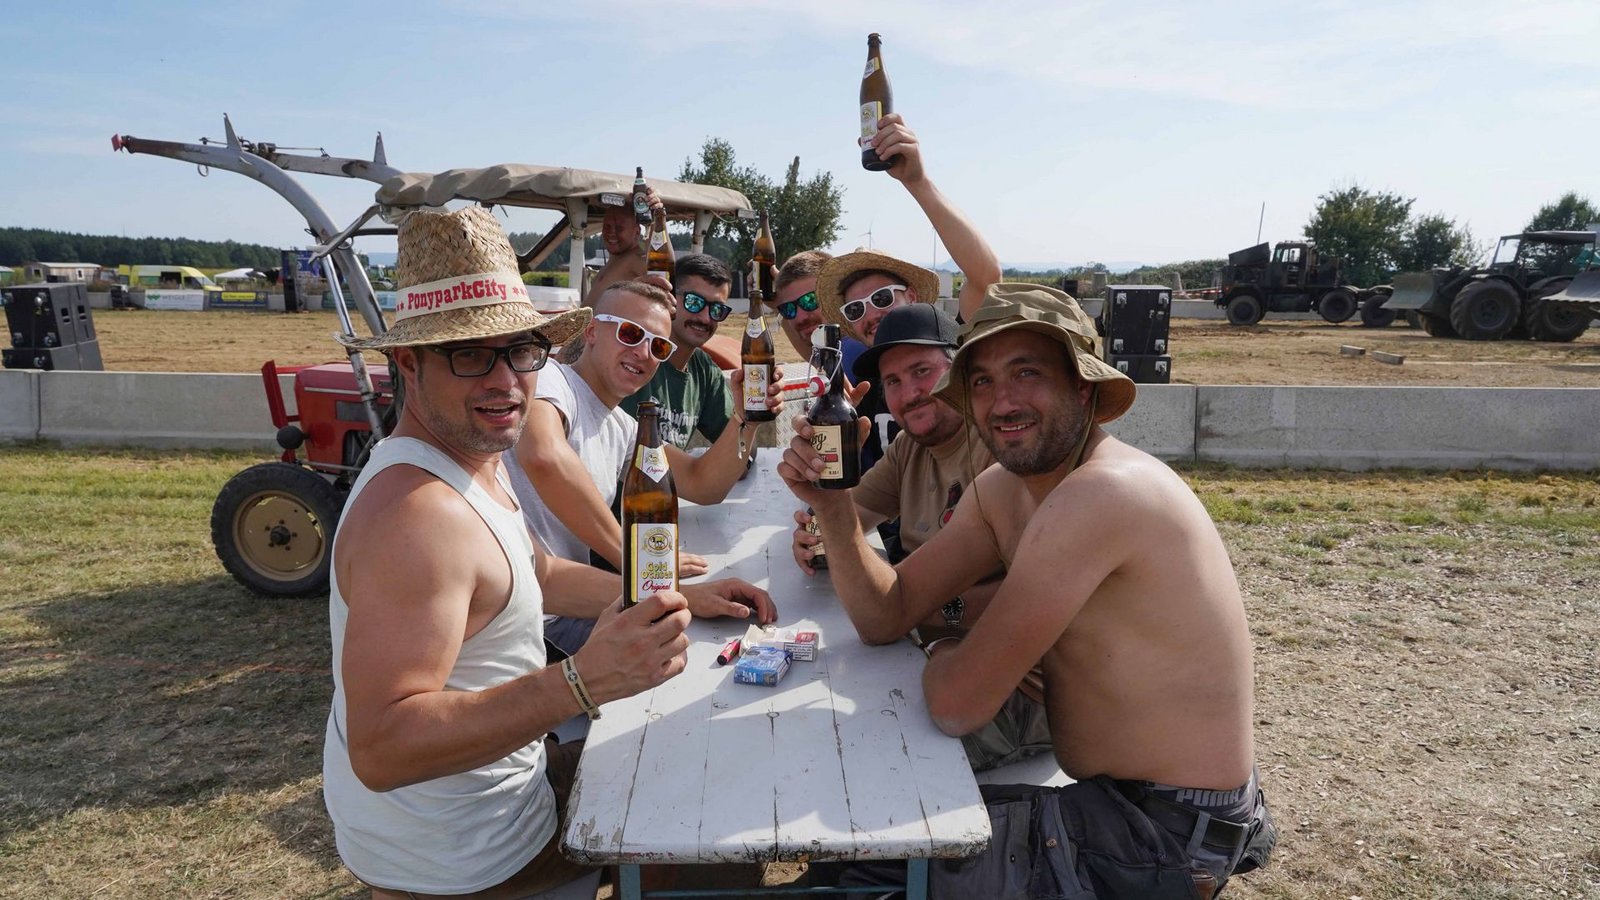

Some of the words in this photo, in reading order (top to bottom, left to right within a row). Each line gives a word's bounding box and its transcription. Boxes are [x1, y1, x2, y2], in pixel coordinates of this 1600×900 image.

[407, 279, 507, 310] PonyparkCity
[647, 561, 668, 571] Gold
[641, 570, 673, 580] Ochsen
[642, 579, 672, 593] Original
[1175, 788, 1239, 807] PUMA
